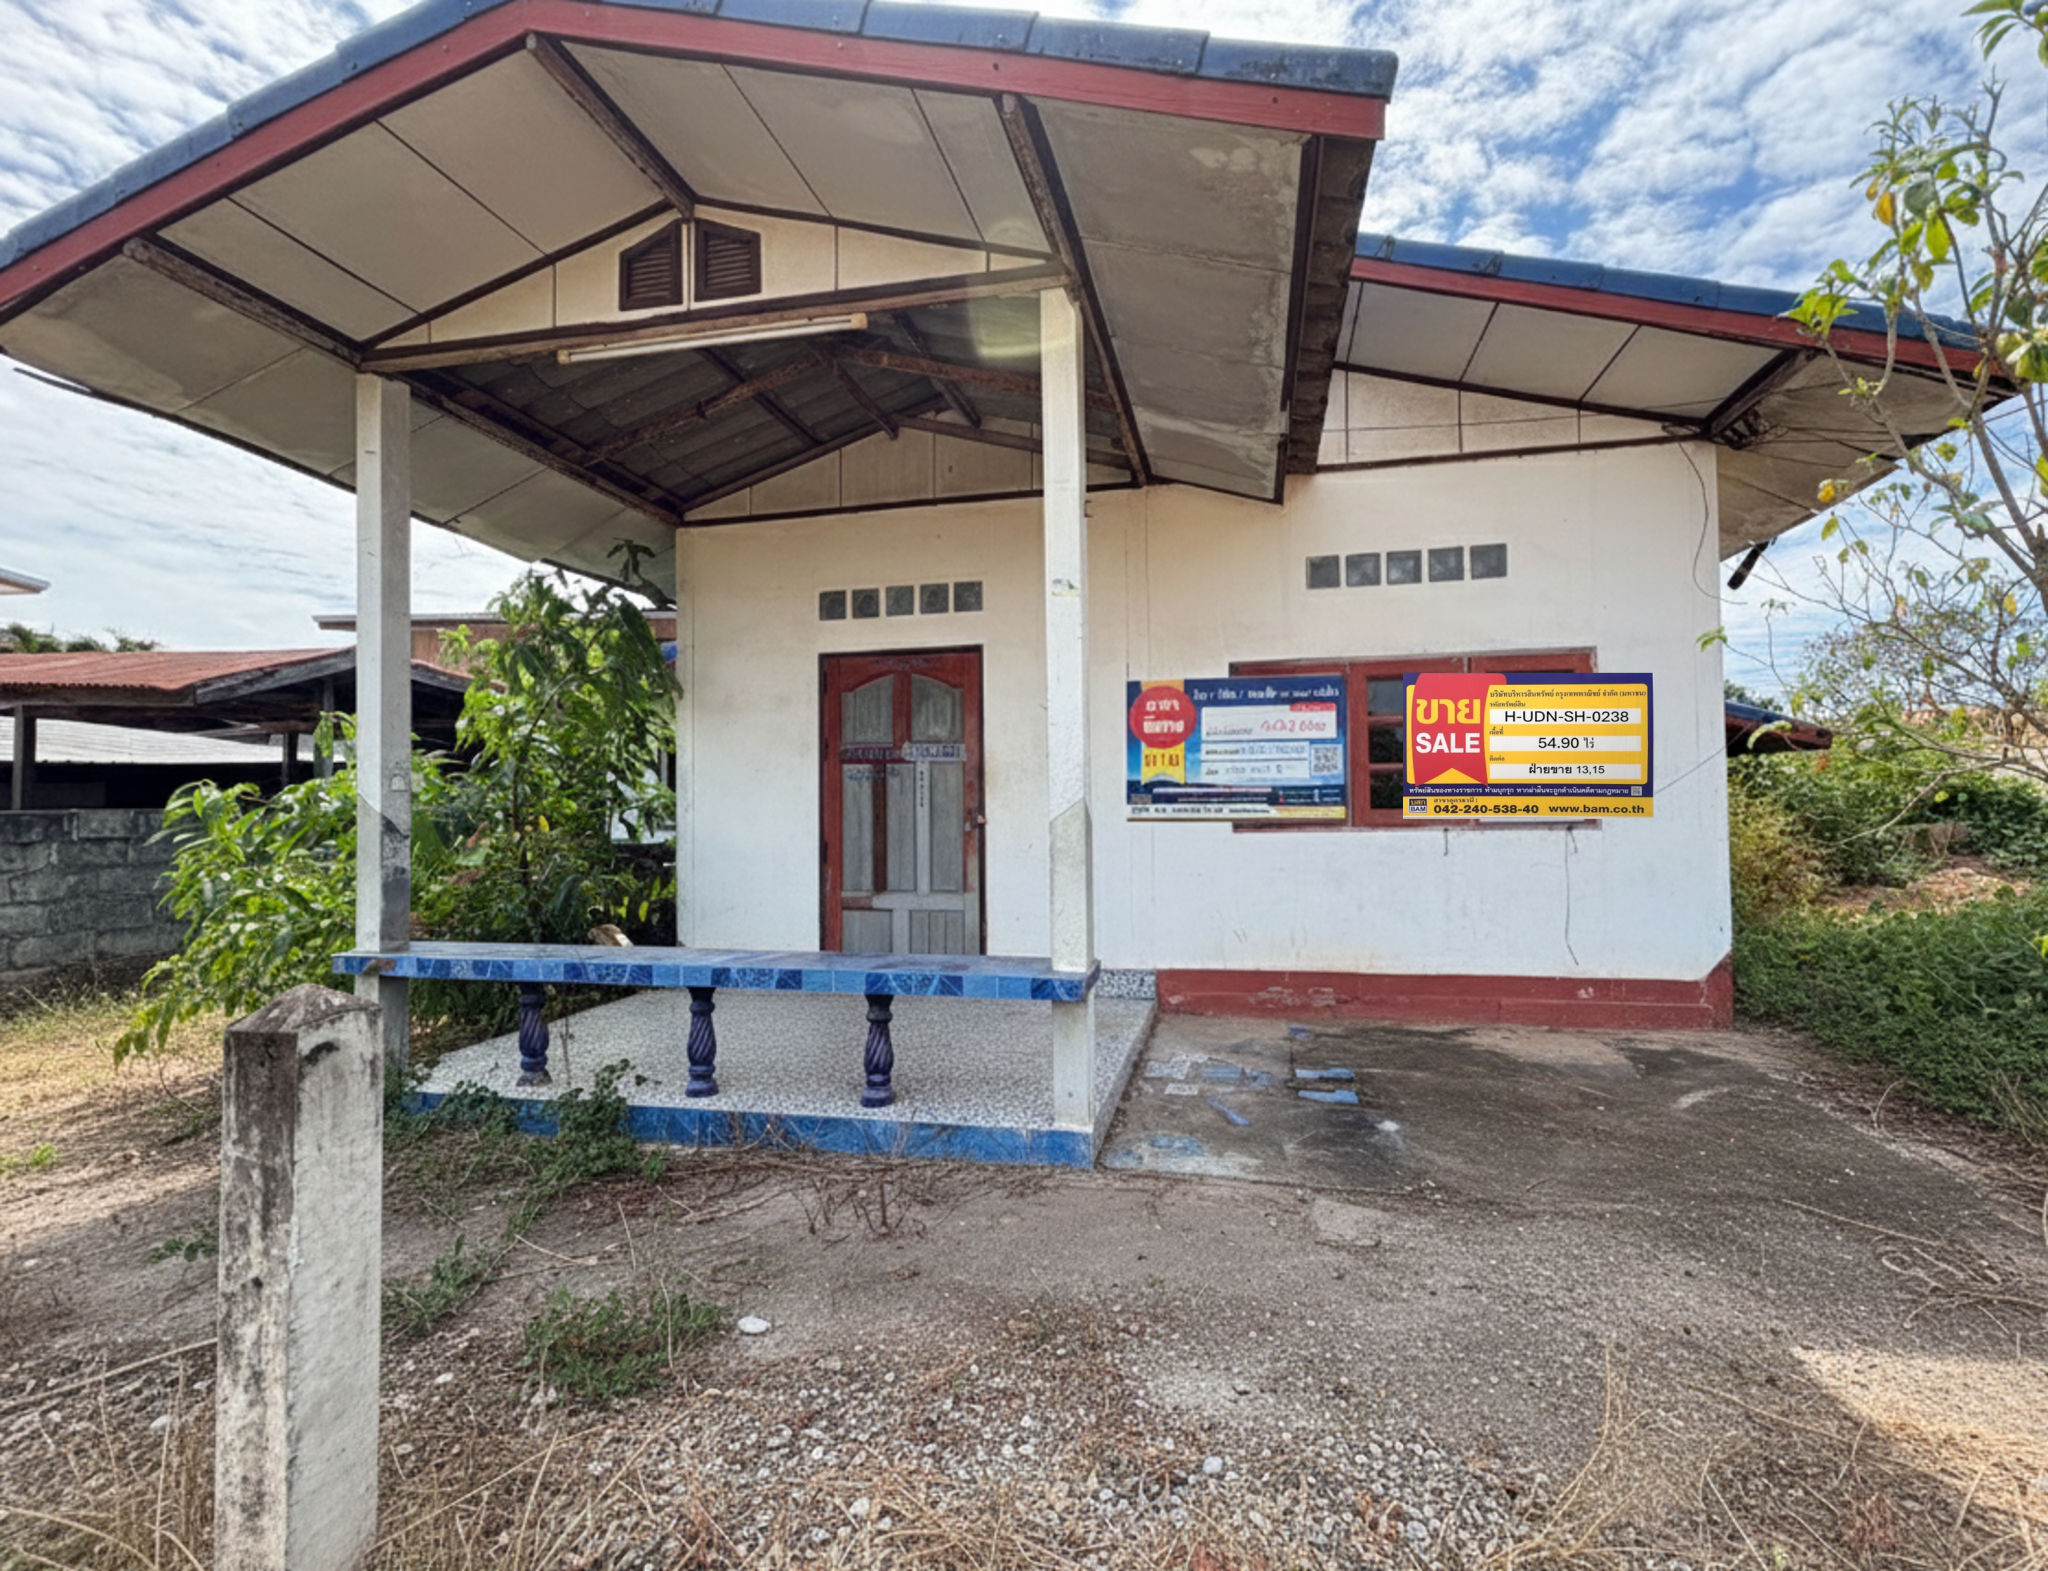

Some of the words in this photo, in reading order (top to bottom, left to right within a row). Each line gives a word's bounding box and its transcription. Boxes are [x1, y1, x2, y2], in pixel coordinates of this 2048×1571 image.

[1416, 698, 1481, 724] ขาย
[1504, 710, 1629, 723] H-UDN-SH-0238
[1415, 732, 1481, 754] SALE
[1538, 737, 1580, 749] 54.90
[1583, 737, 1595, 749] ไร่
[1528, 763, 1573, 775] ฝ่ายขาย
[1577, 765, 1605, 776] 13,15
[1433, 804, 1539, 814] 042-240-538-40
[1548, 805, 1645, 814] www.bam.co.th
